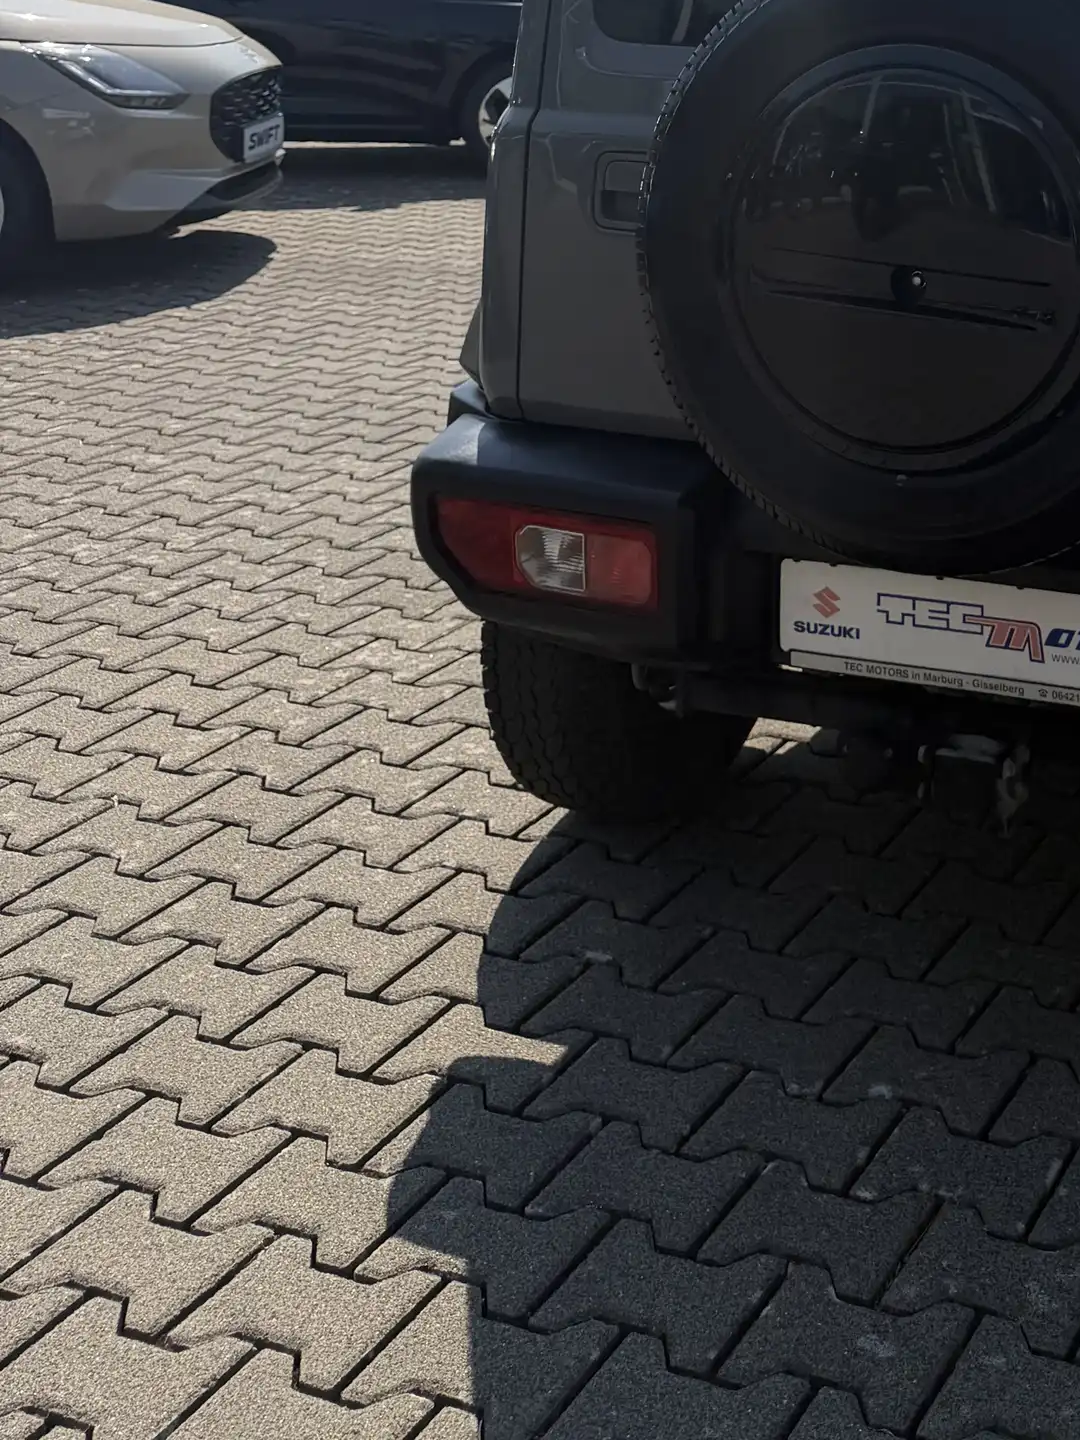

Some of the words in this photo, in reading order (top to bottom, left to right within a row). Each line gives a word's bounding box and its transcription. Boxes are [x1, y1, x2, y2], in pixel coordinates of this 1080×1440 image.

[248, 124, 280, 150] SWIFT
[793, 620, 860, 640] SUZUKI
[843, 661, 863, 673] TEC
[866, 664, 909, 679] MOTORS
[911, 671, 921, 681] in
[923, 672, 963, 688] Marburg
[972, 678, 1025, 697] Gisselberg
[1052, 690, 1080, 704] 06421
